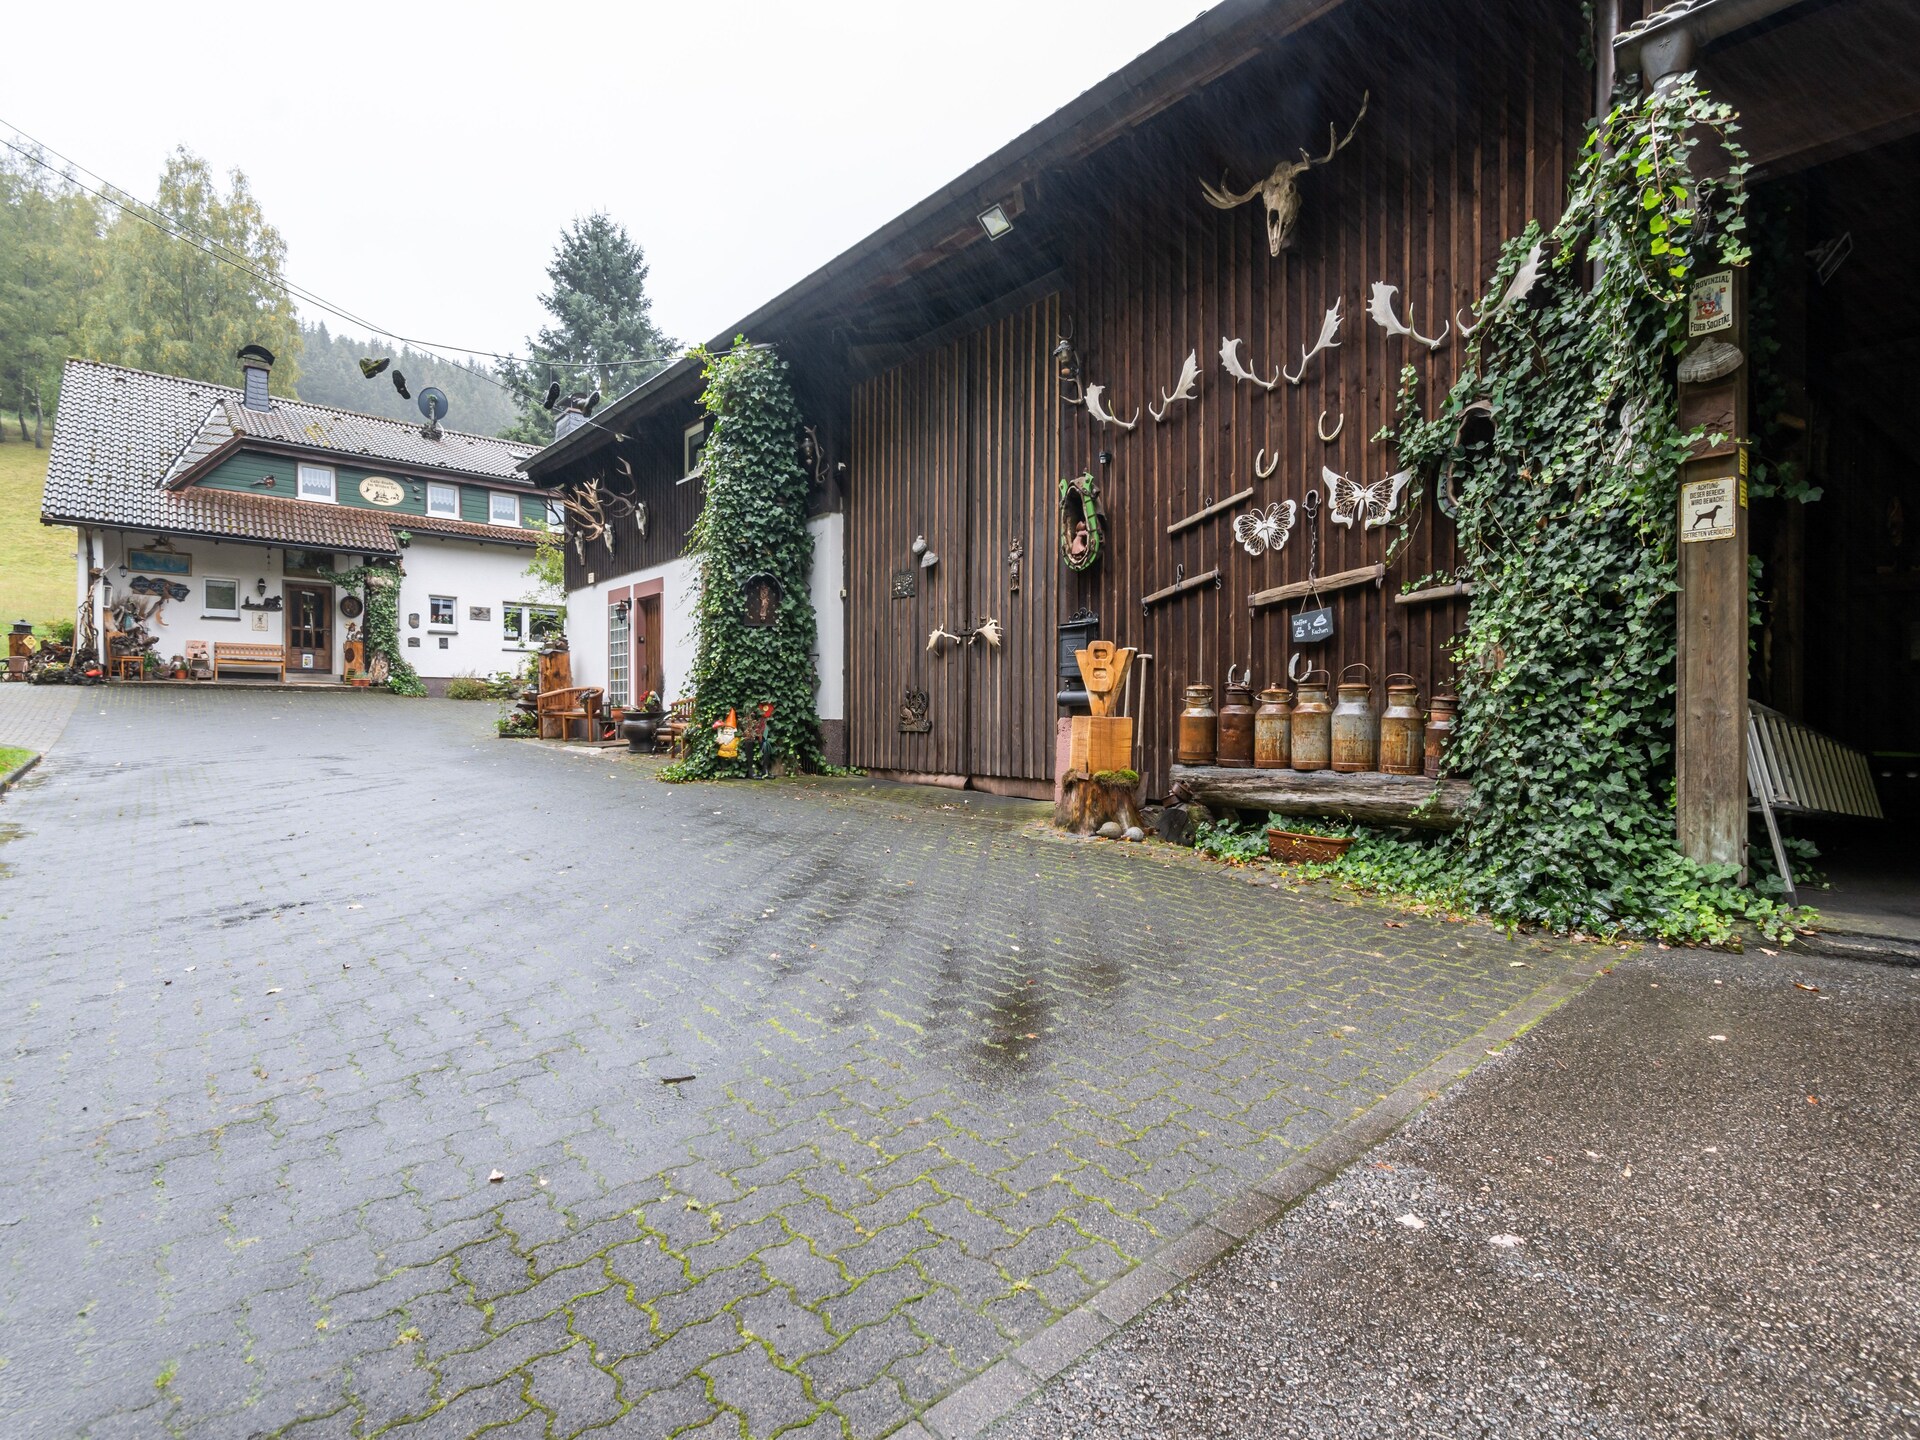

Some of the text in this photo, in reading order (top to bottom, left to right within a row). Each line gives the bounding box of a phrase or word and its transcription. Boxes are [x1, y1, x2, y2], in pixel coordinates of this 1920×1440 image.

[1691, 275, 1730, 290] PROVINZIAL
[1690, 488, 1726, 499] DIESER BEREICH
[1293, 618, 1308, 626] Kaffee
[1311, 627, 1329, 636] Kuchen
